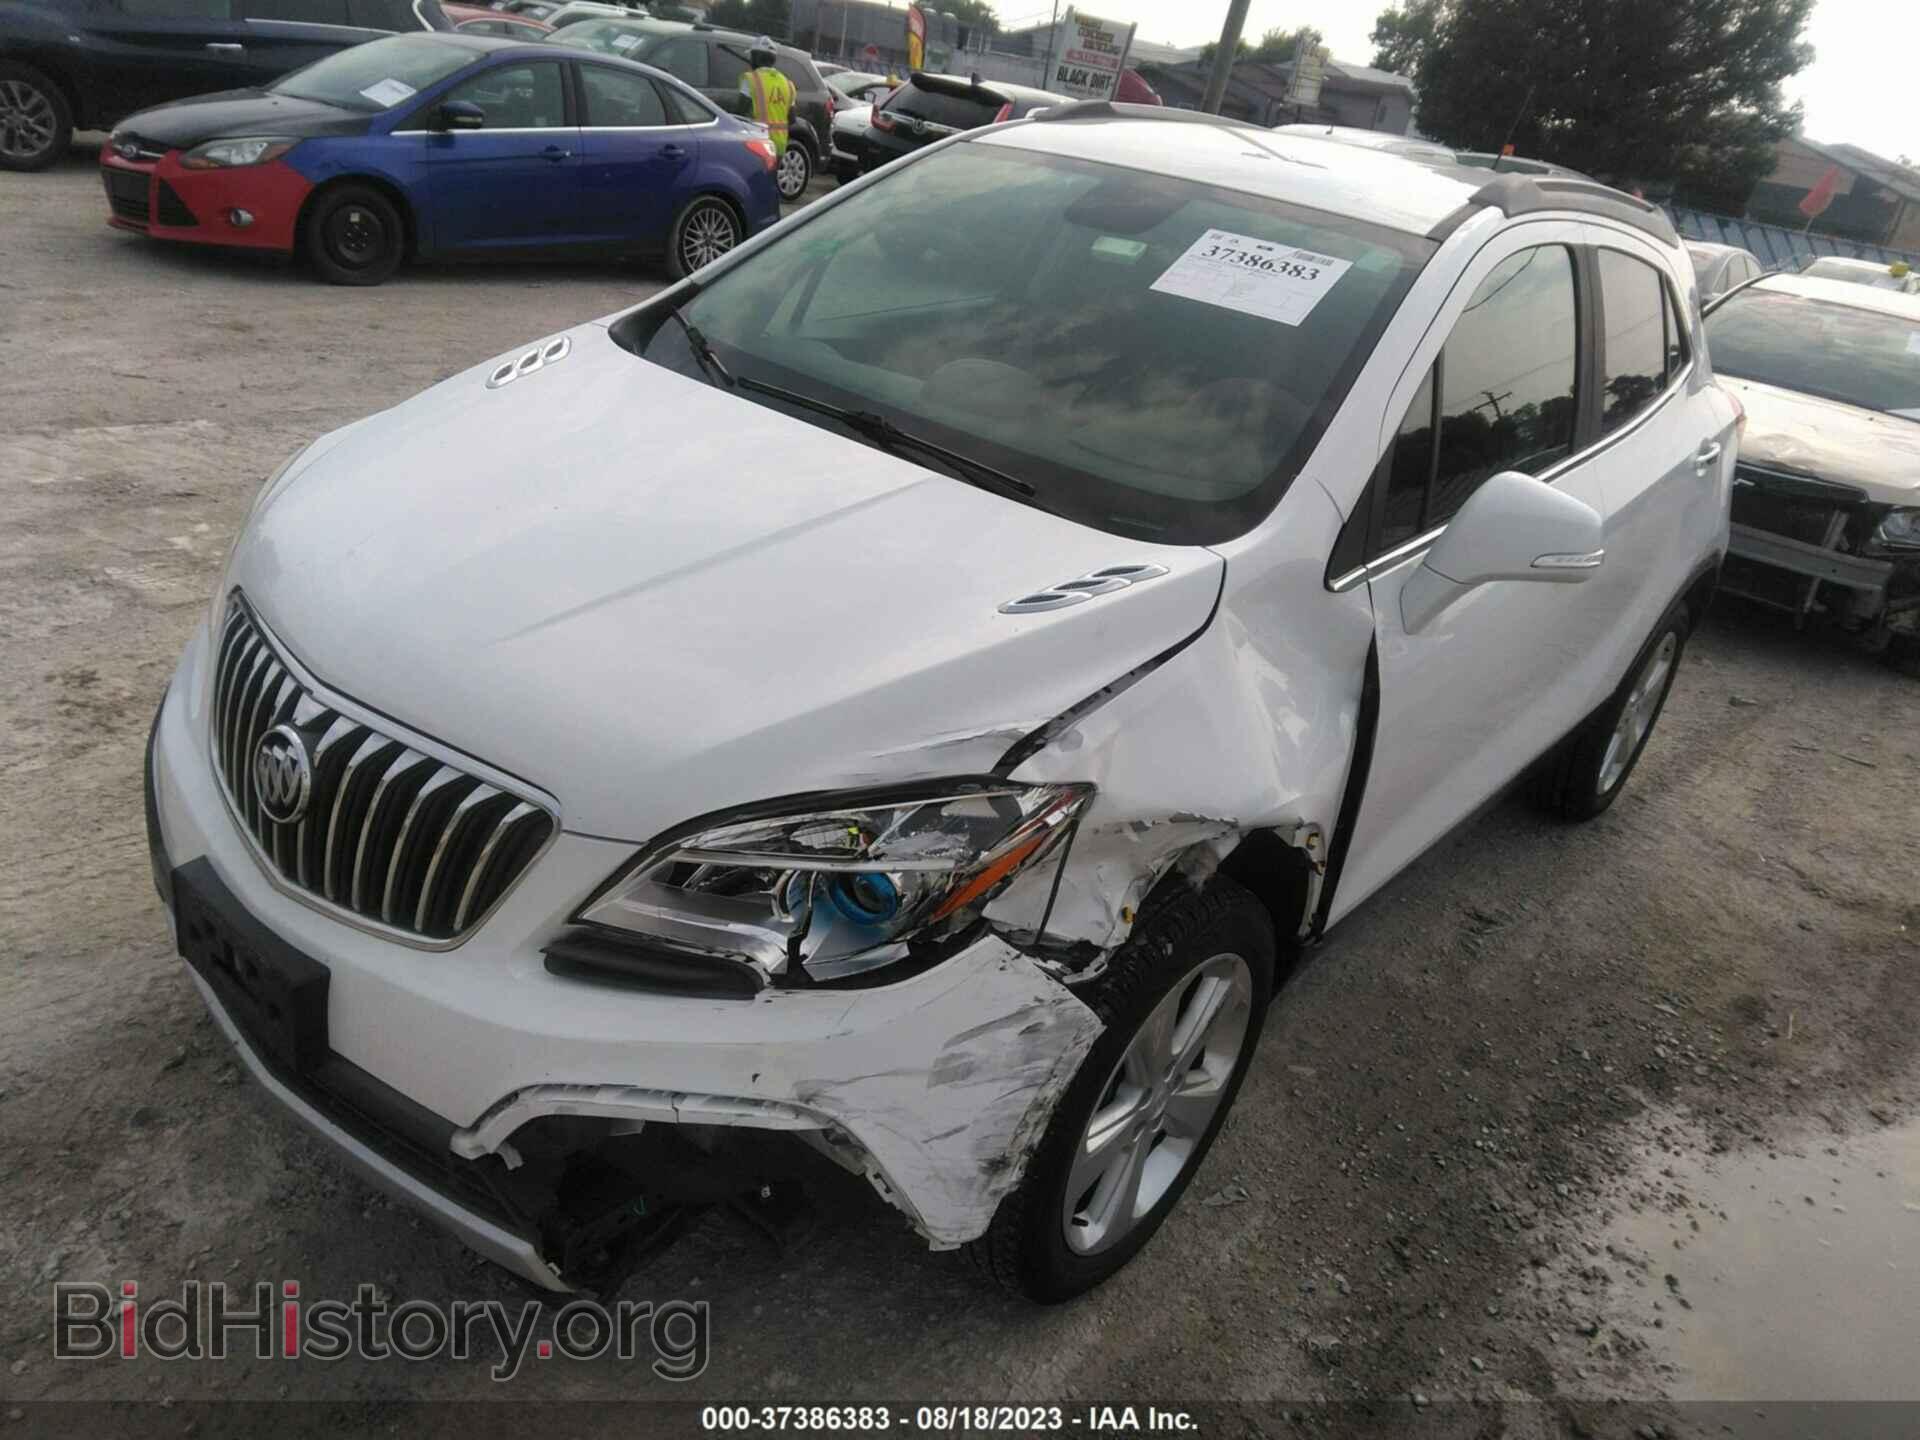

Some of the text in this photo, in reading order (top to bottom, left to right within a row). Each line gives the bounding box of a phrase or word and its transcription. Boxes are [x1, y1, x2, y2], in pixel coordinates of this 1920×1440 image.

[1057, 65, 1088, 88] BLACK
[1089, 72, 1113, 91] DIRT
[1201, 244, 1321, 281] 37386383
